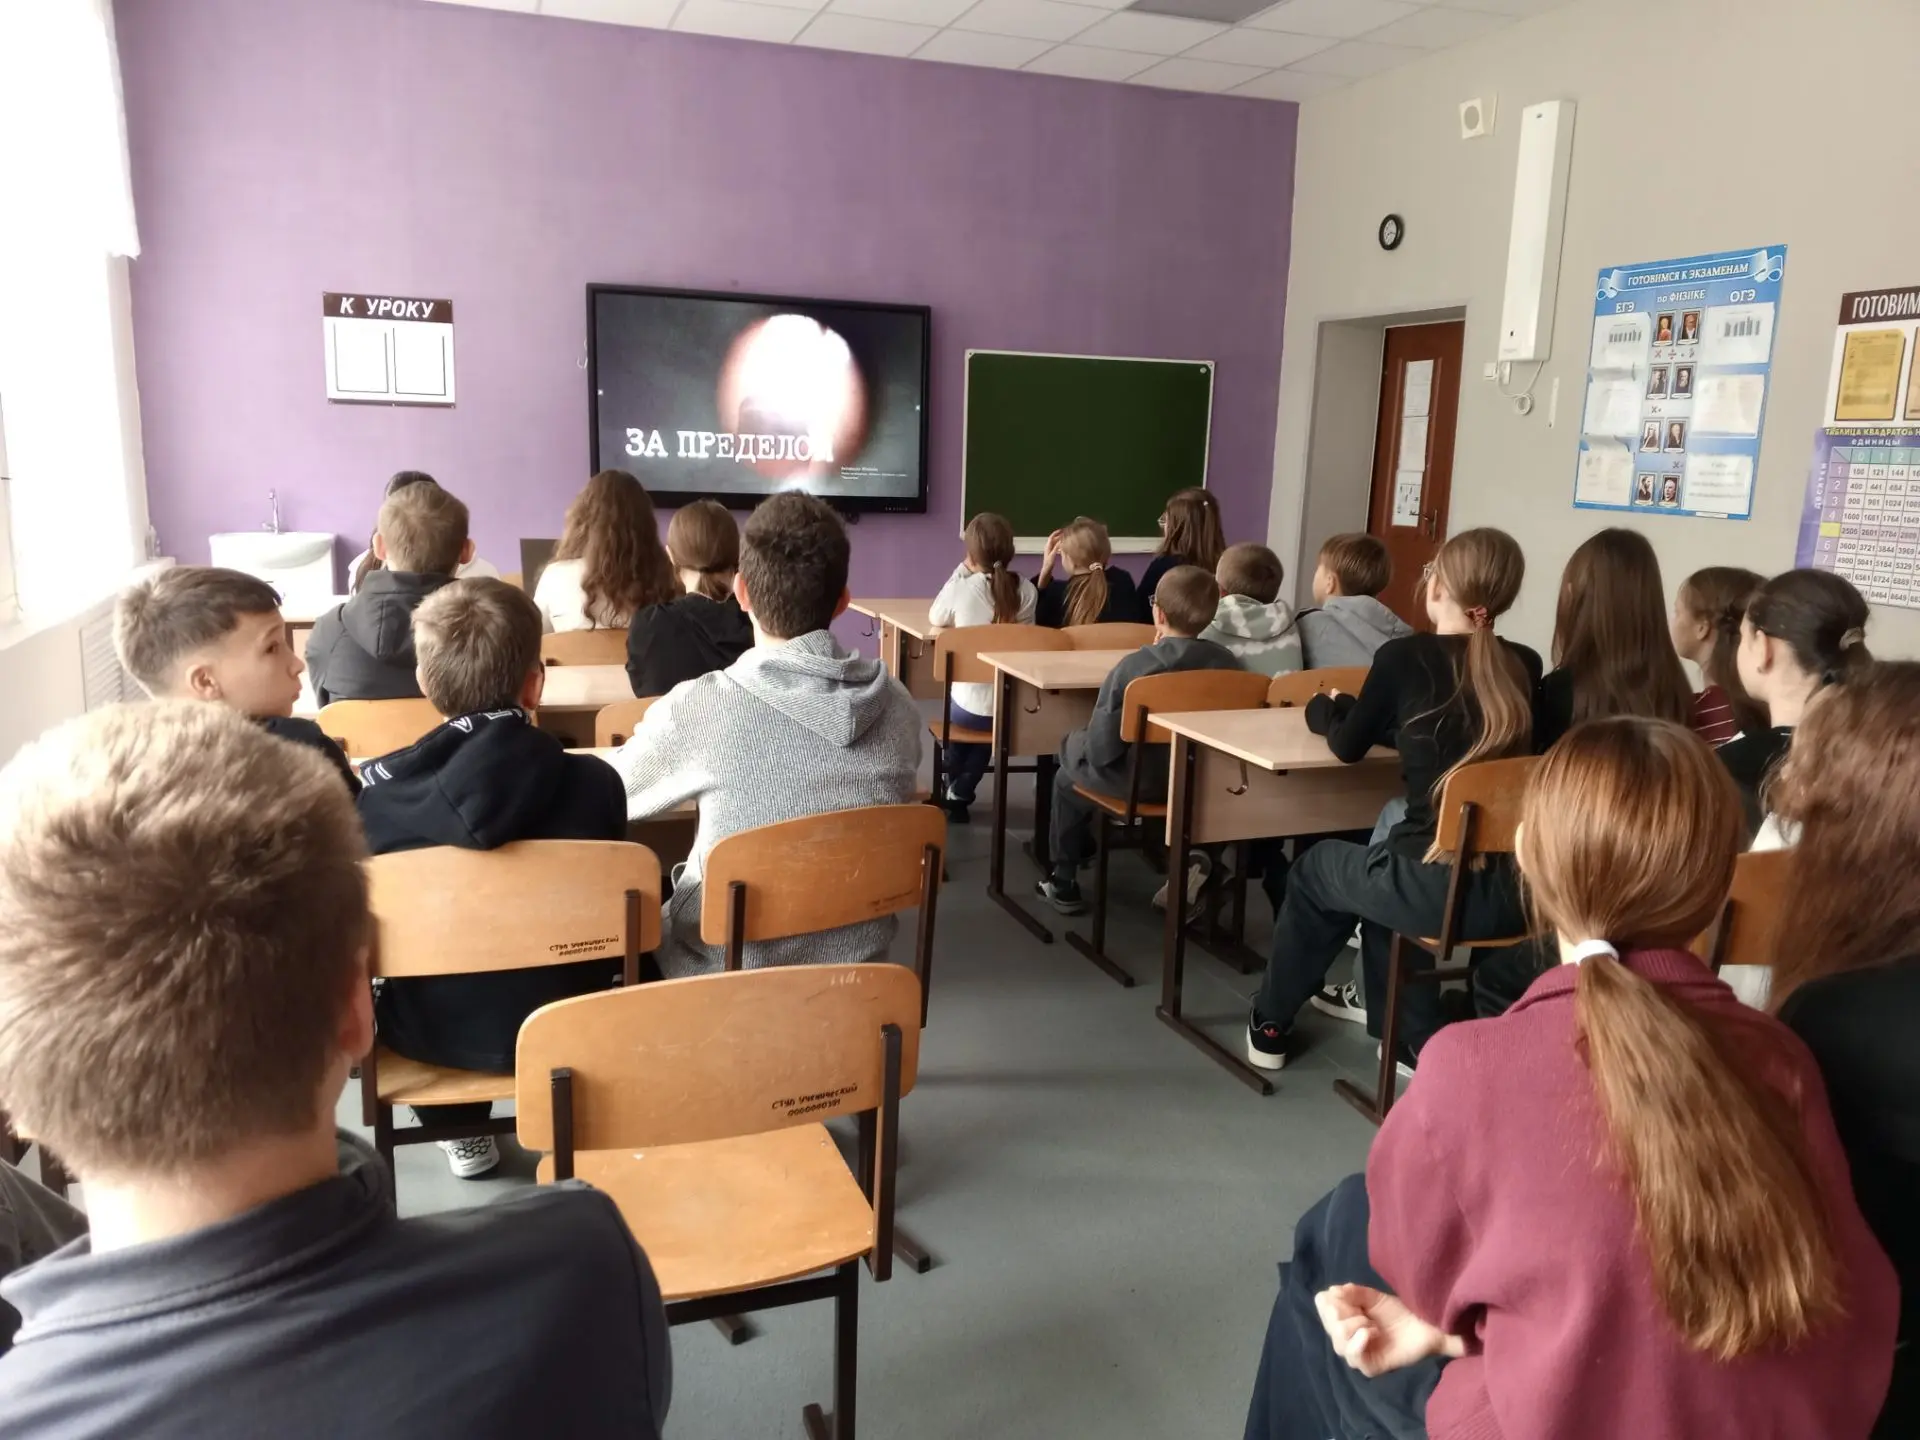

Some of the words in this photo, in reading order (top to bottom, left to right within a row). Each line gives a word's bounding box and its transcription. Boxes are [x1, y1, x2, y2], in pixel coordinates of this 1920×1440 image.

[1628, 270, 1680, 286] ГОТОВИМСЯ
[1681, 269, 1688, 280] К
[1689, 263, 1749, 279] ЭКЗАМЕНАМ
[1669, 289, 1706, 302] ФИЗИКЕ
[1729, 289, 1756, 303] ОГЭ
[340, 297, 355, 314] К
[366, 298, 434, 318] УРОКУ
[1615, 301, 1635, 313] ЕГЭ
[1852, 292, 1920, 319] ГОТОВИМ
[1825, 428, 1861, 436] ТАБЛИЦА
[1863, 428, 1913, 436] КВАДРАТОВ
[625, 428, 668, 458] ЗА
[1873, 468, 1884, 476] 121
[1861, 528, 1878, 536] 2601
[1895, 562, 1912, 570] 5329
